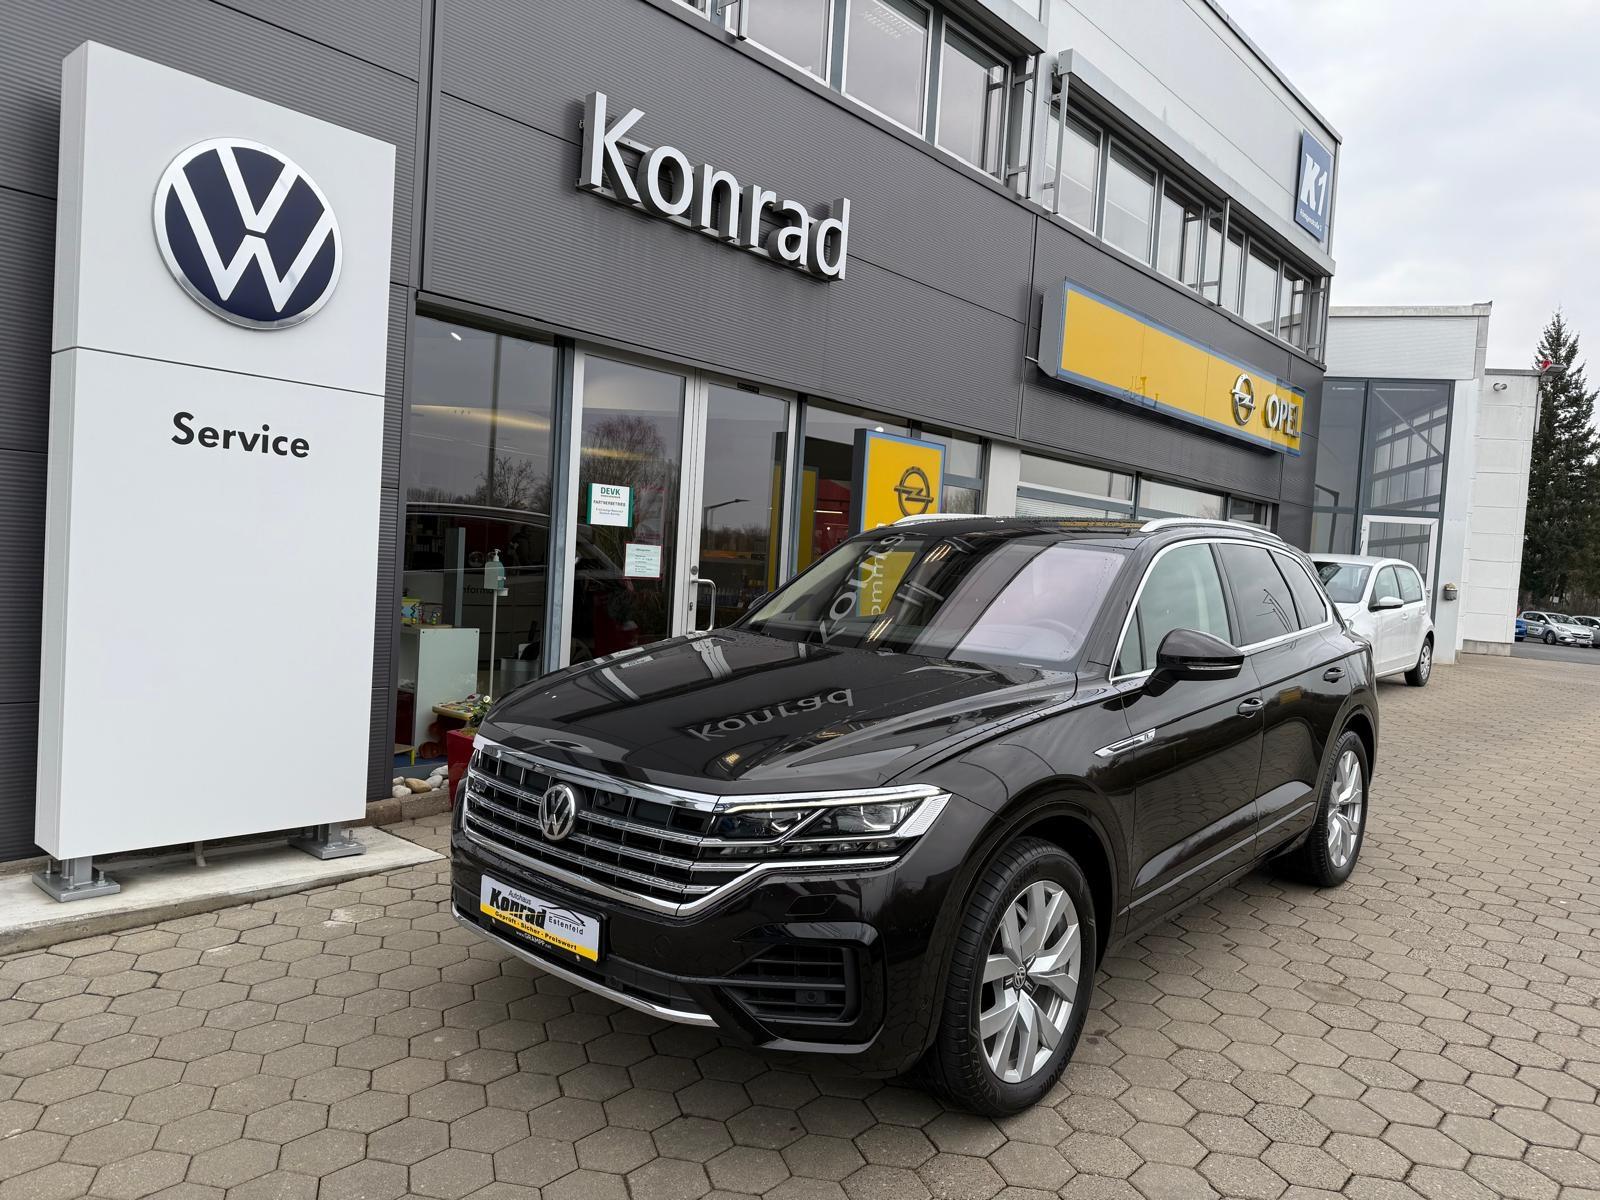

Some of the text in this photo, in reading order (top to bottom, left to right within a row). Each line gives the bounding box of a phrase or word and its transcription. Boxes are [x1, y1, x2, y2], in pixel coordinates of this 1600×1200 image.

[581, 91, 850, 281] Konrad
[1300, 153, 1328, 217] K1
[171, 411, 310, 458] Service
[600, 486, 621, 496] DEVK
[489, 887, 547, 930] Konrad
[508, 889, 532, 906] Autohaus
[548, 915, 584, 936] Estenfeld
[544, 933, 578, 951] Preiswert
